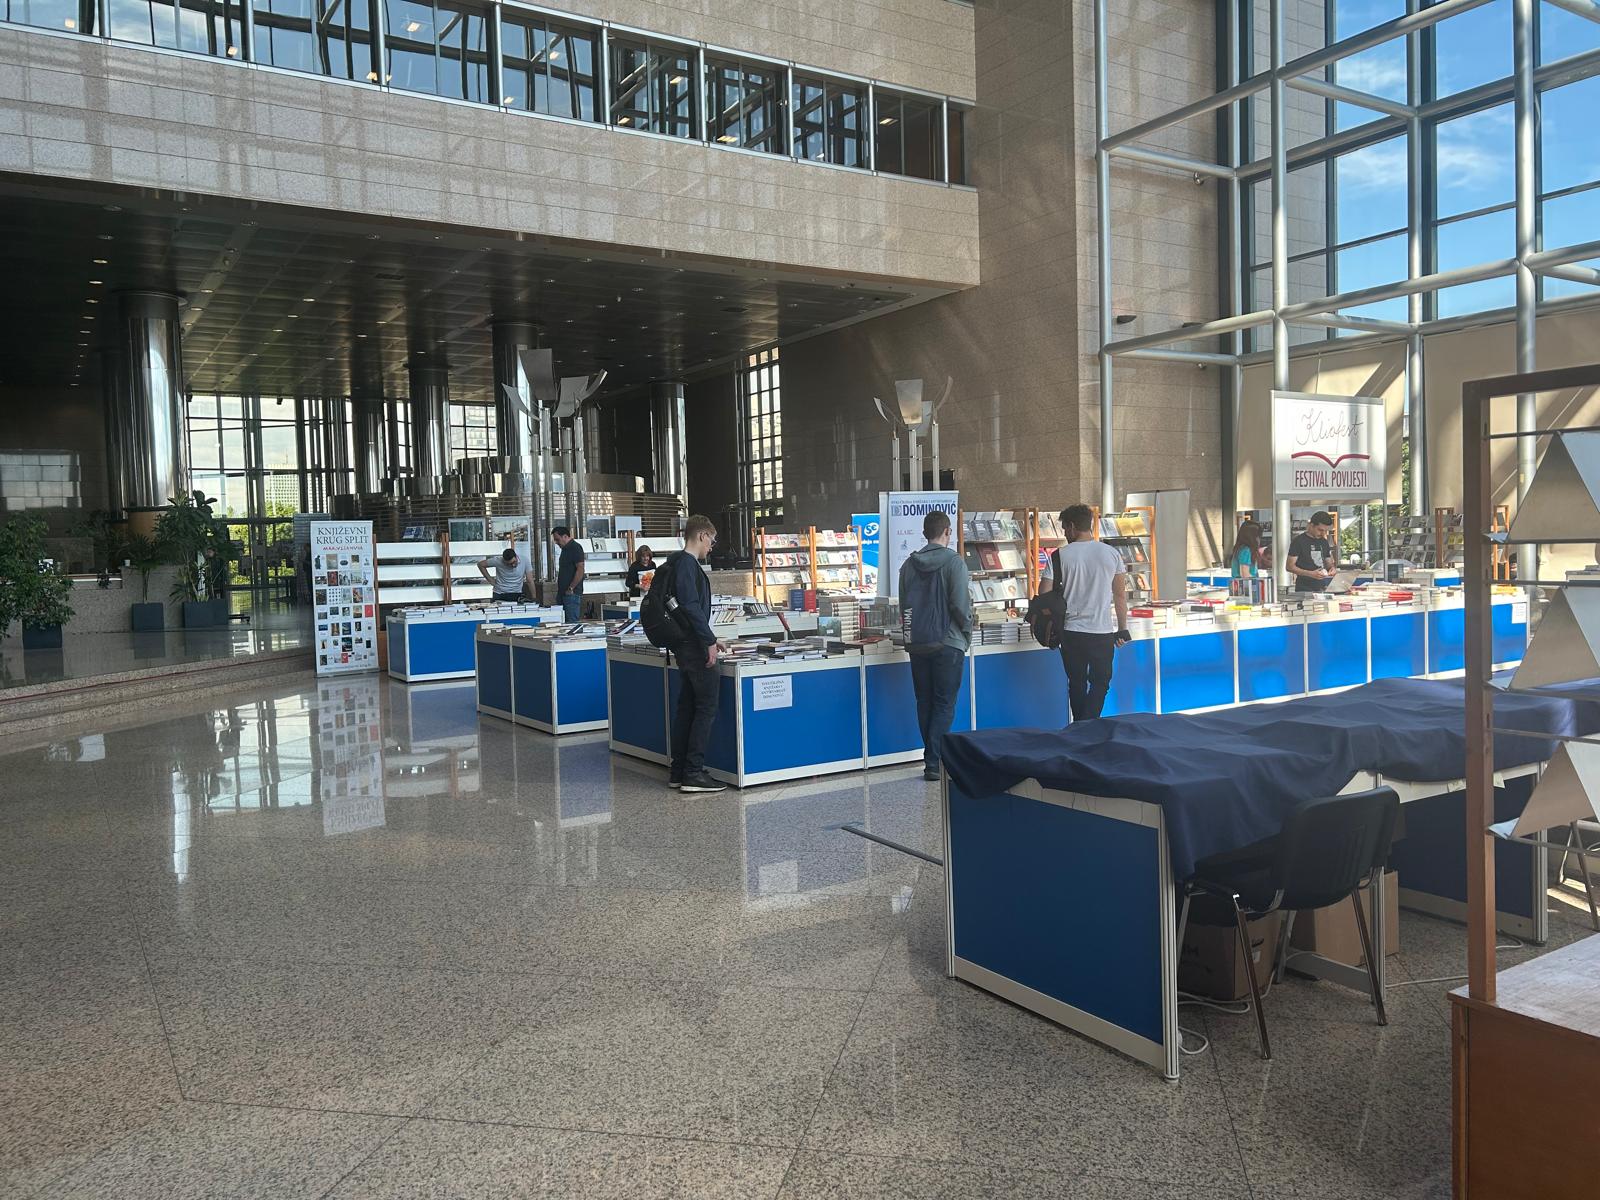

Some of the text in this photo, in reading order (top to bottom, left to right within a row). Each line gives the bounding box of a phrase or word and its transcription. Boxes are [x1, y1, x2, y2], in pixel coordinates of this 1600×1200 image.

[1295, 470, 1367, 487] FESTIVAL POVIJESTI
[902, 500, 957, 516] DOMINOVIĆ
[317, 526, 367, 536] KNJIŽEVNI
[316, 536, 369, 544] KRUG SPLIT
